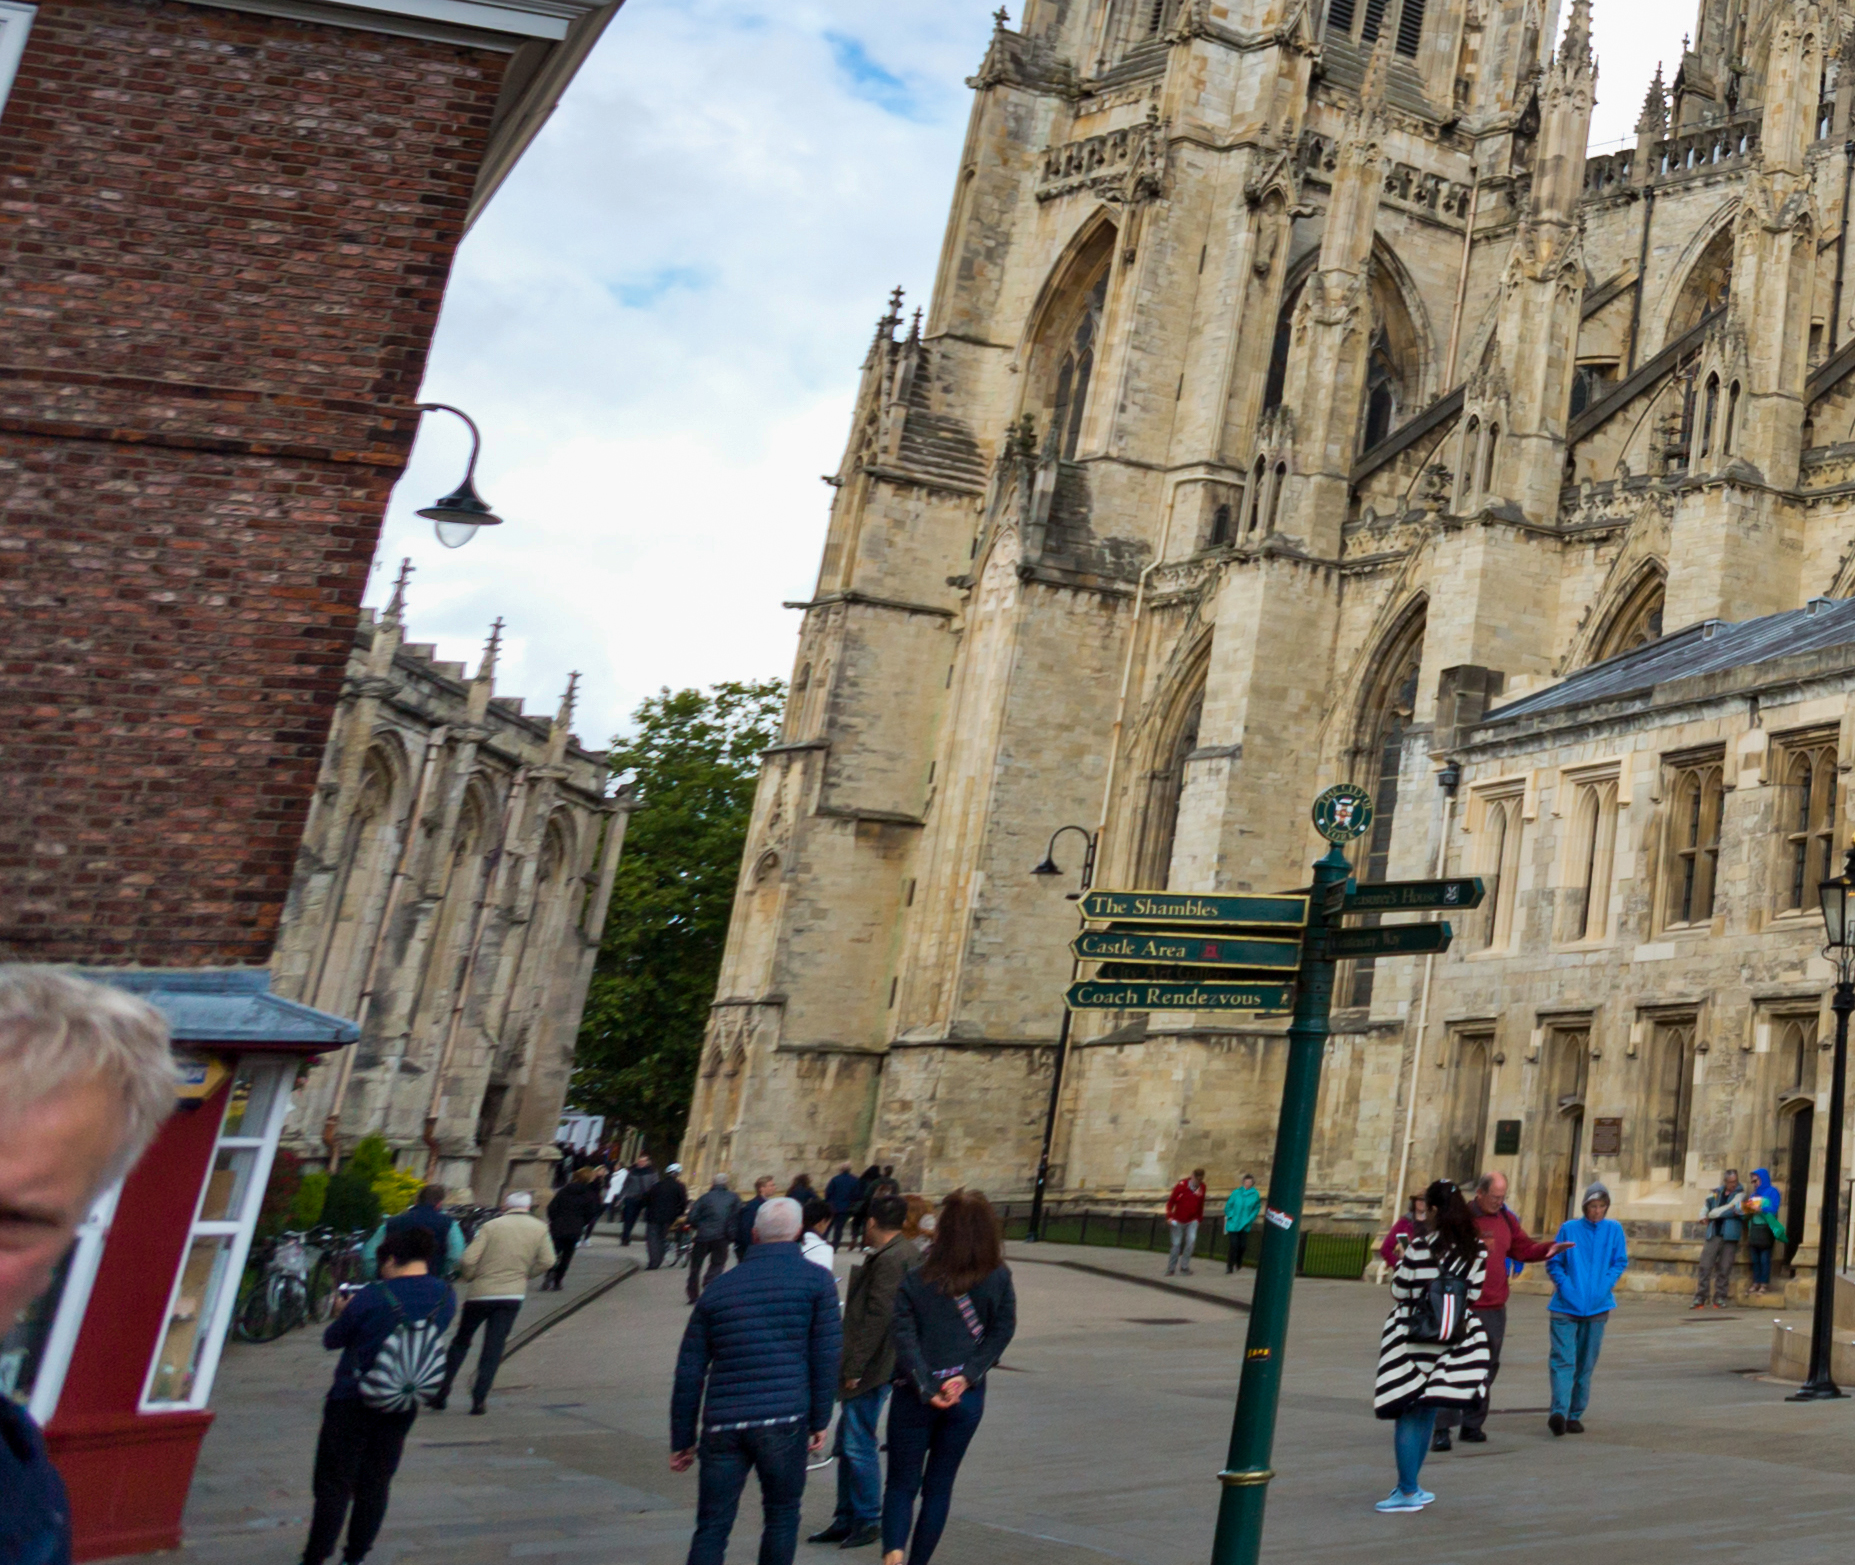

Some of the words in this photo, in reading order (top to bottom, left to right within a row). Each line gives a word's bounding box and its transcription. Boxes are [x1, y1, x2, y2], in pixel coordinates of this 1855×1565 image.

[1091, 896, 1127, 914] The
[1132, 898, 1219, 916] Shambles
[1353, 890, 1398, 906] easurer's
[1401, 887, 1439, 904] House
[1082, 936, 1136, 955] Castle
[1140, 940, 1187, 958] Area
[1144, 965, 1172, 980] Art
[1076, 987, 1138, 1005] Coach
[1146, 988, 1262, 1006] Rendezvous
